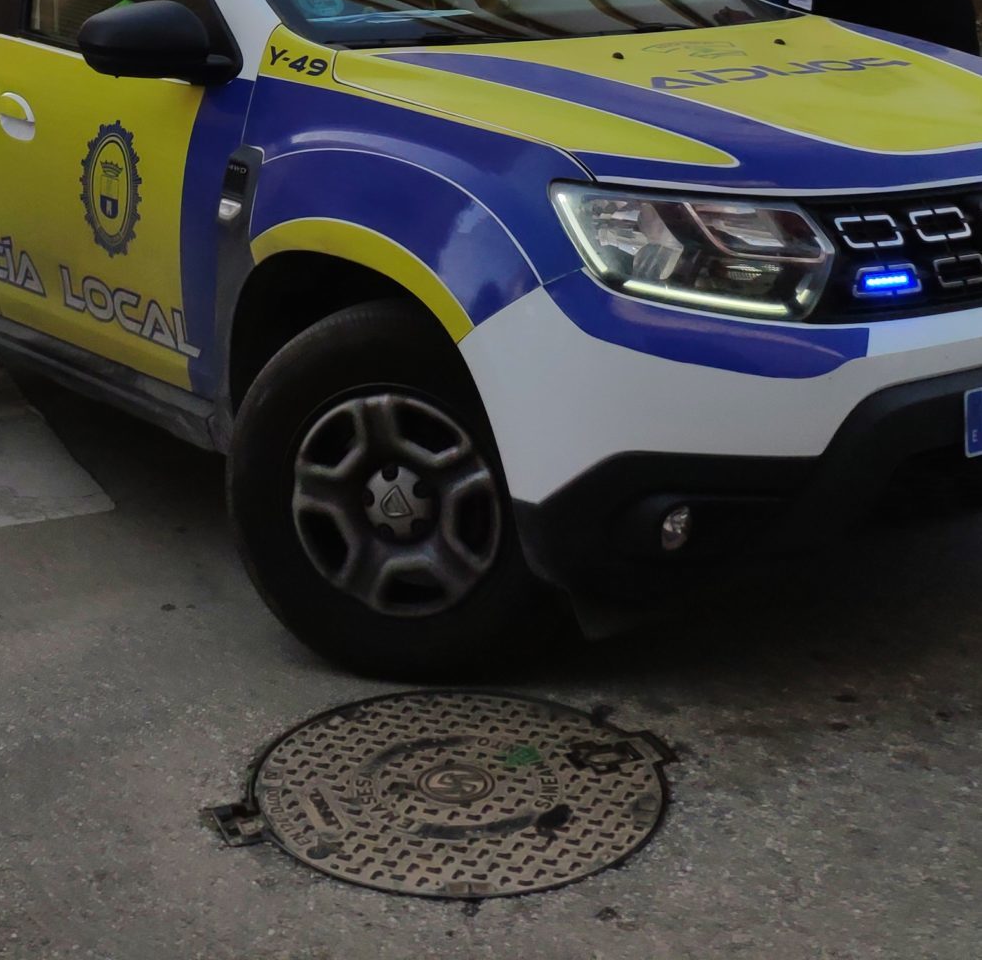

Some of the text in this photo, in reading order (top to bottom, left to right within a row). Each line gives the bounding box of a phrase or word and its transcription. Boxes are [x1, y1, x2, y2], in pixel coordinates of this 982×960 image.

[270, 46, 328, 76] Y-49
[60, 264, 201, 358] LOCAL
[477, 736, 559, 809] SANEAMNTO
